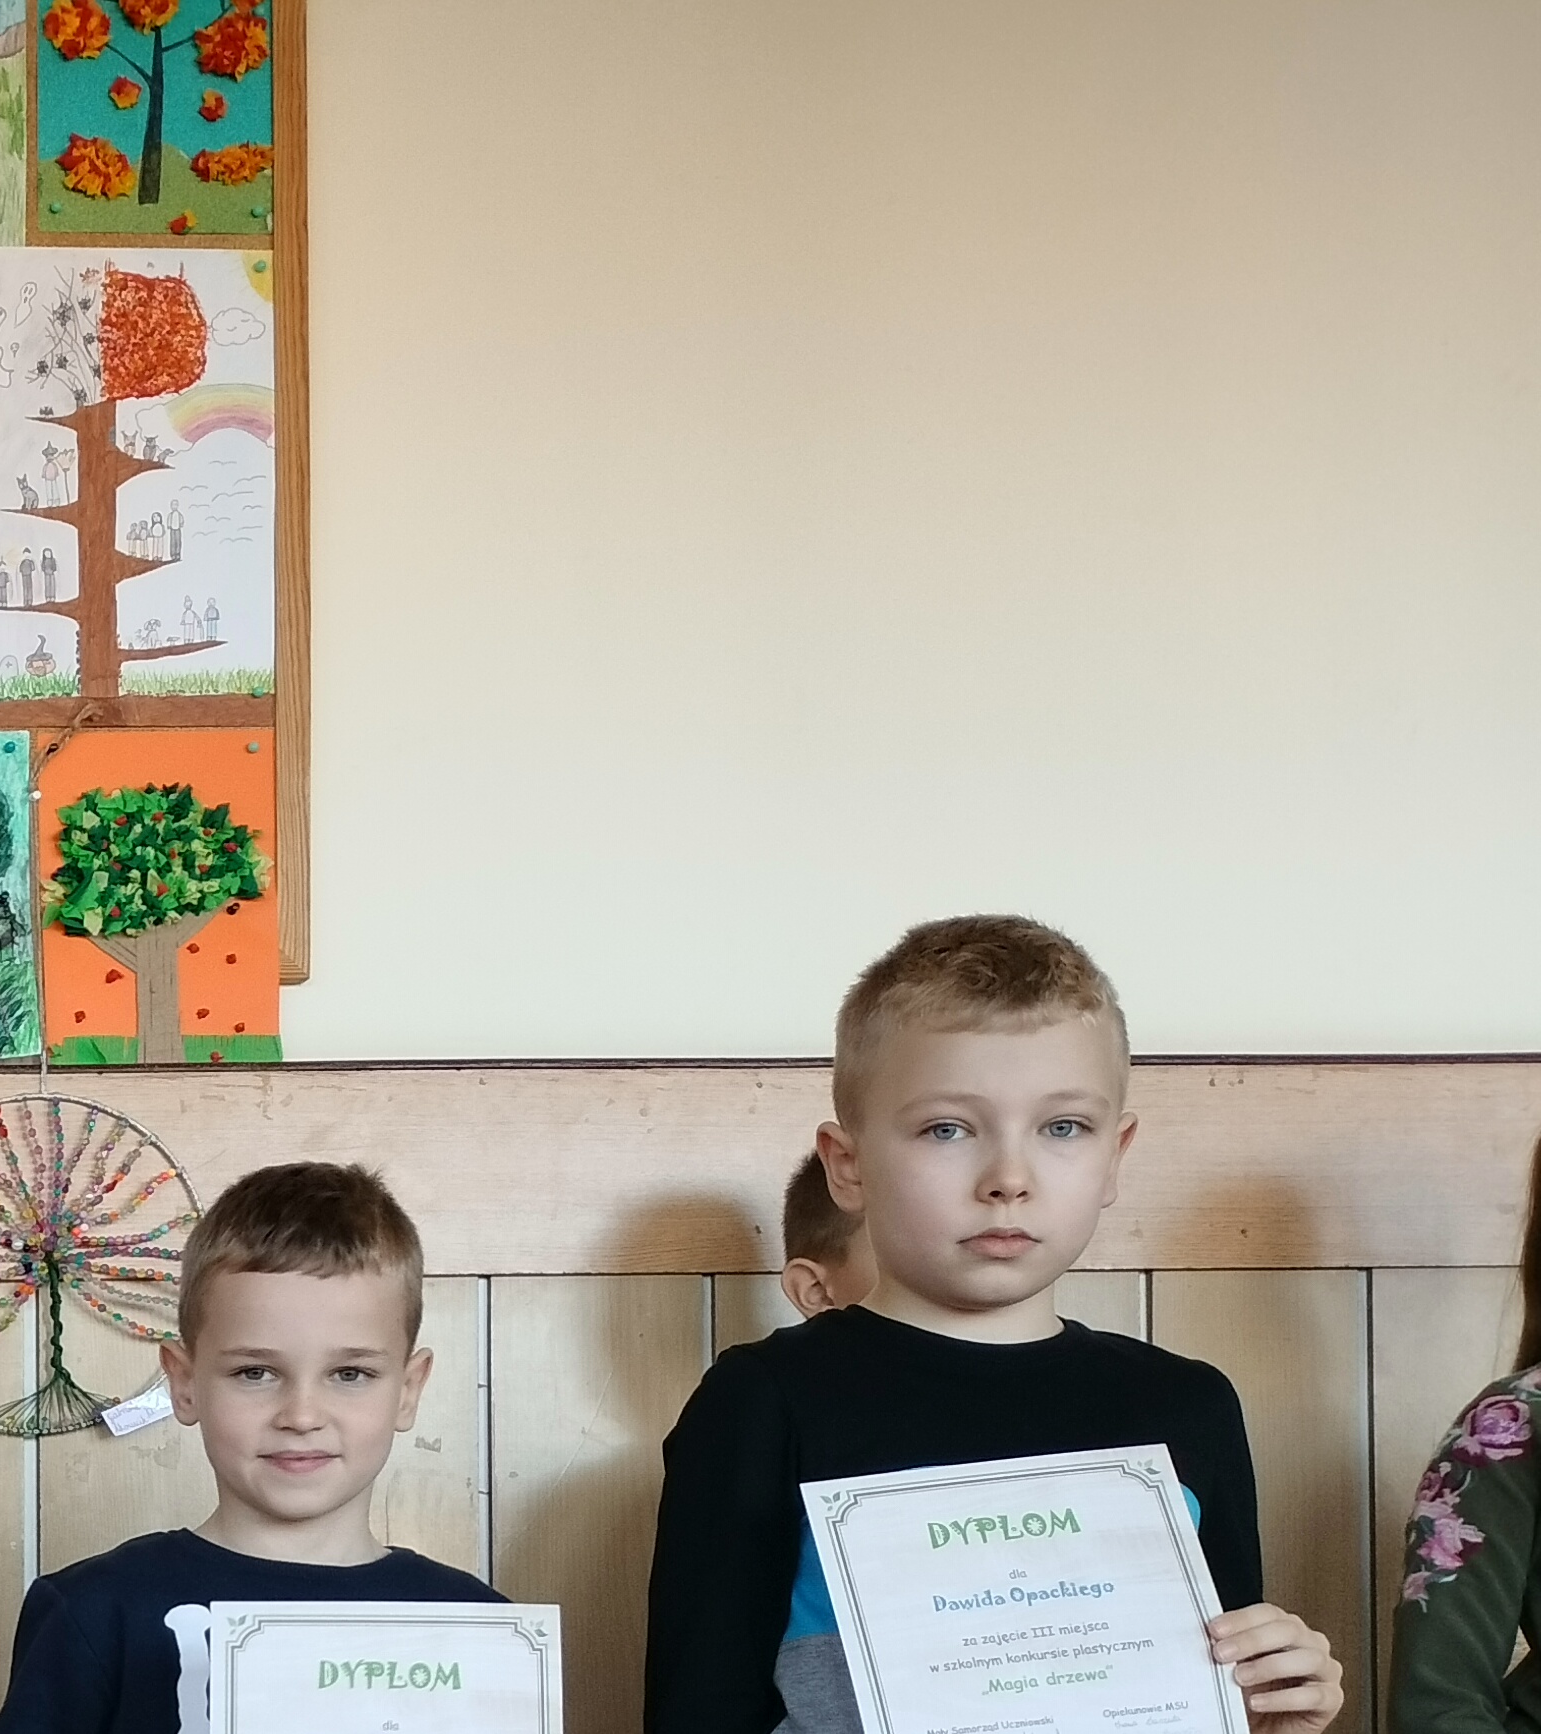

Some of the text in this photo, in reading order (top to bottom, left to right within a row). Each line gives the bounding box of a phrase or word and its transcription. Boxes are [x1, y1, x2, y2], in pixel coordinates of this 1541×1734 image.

[927, 1508, 1081, 1549] DYPLOM
[1009, 1569, 1027, 1580] dla
[933, 1580, 1114, 1612] Dawida Opackiego
[962, 1621, 1109, 1647] za zajęcie III miejsca
[930, 1639, 1154, 1673] w szkolnym konkursie plastycznym
[318, 1659, 461, 1691] DYPLOM
[383, 1720, 399, 1731] dla
